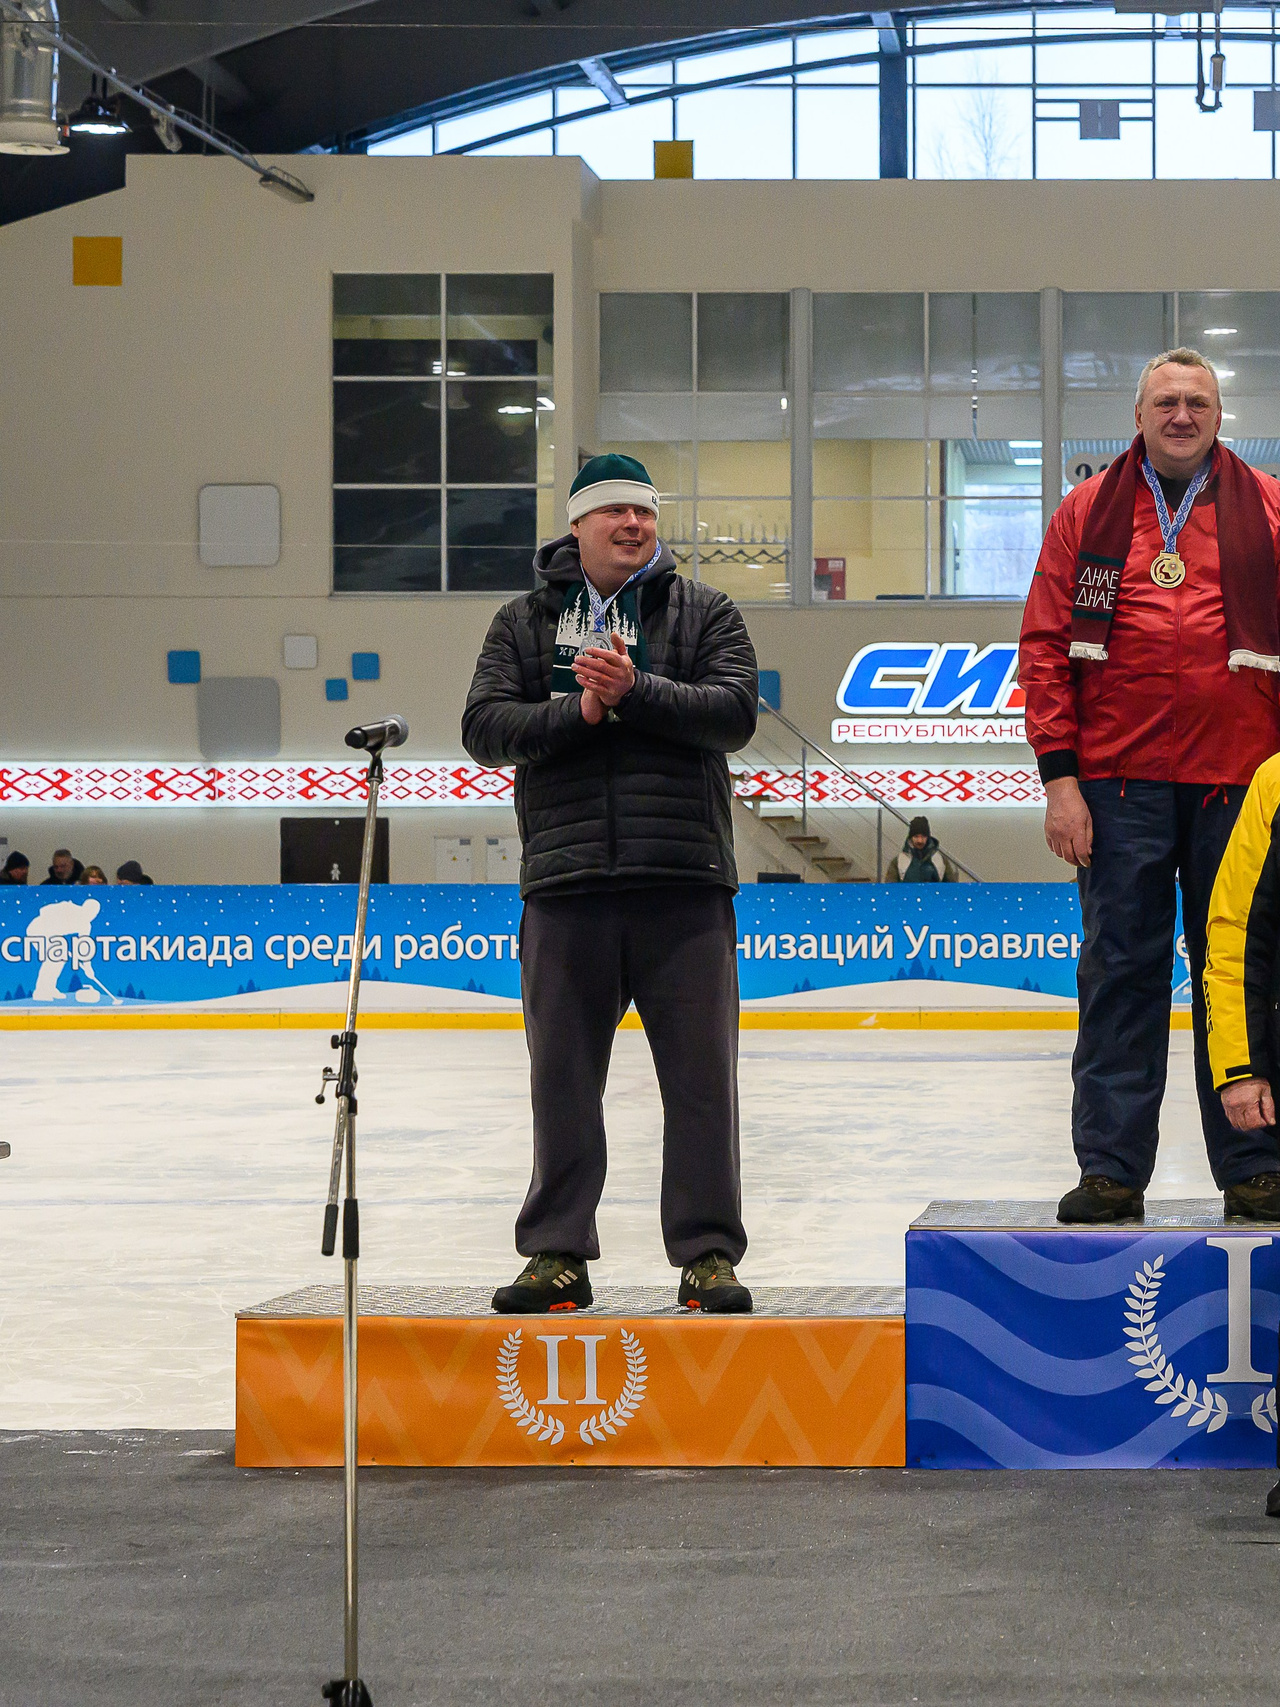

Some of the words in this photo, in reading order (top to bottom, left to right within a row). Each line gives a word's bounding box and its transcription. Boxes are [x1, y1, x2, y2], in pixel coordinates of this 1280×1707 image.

[841, 648, 1027, 709] СИ
[1, 934, 254, 971] спартакиада
[265, 934, 382, 970] среди
[1206, 1236, 1273, 1382] I
[536, 1334, 608, 1405] II
